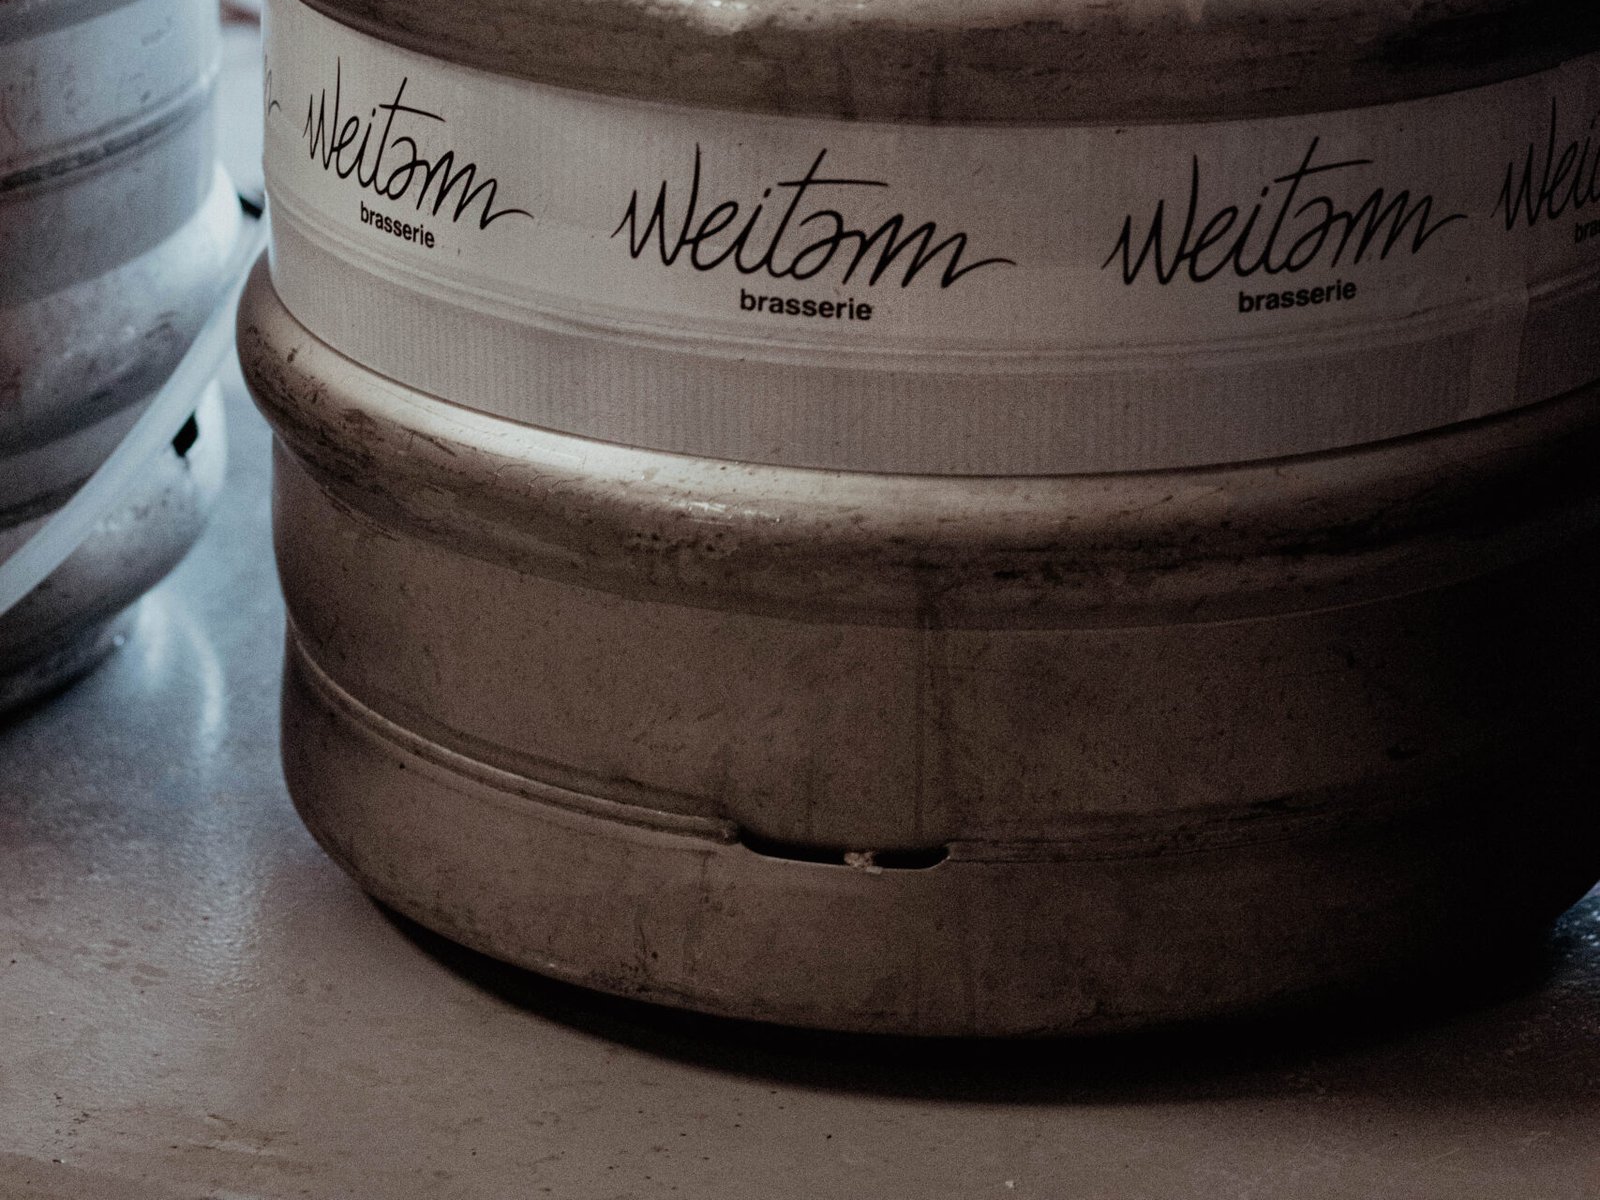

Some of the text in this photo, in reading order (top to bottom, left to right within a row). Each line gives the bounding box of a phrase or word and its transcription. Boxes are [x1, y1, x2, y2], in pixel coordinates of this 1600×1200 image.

[360, 201, 437, 250] brasserie
[739, 288, 875, 323] brasserie
[1238, 279, 1358, 314] brasserie
